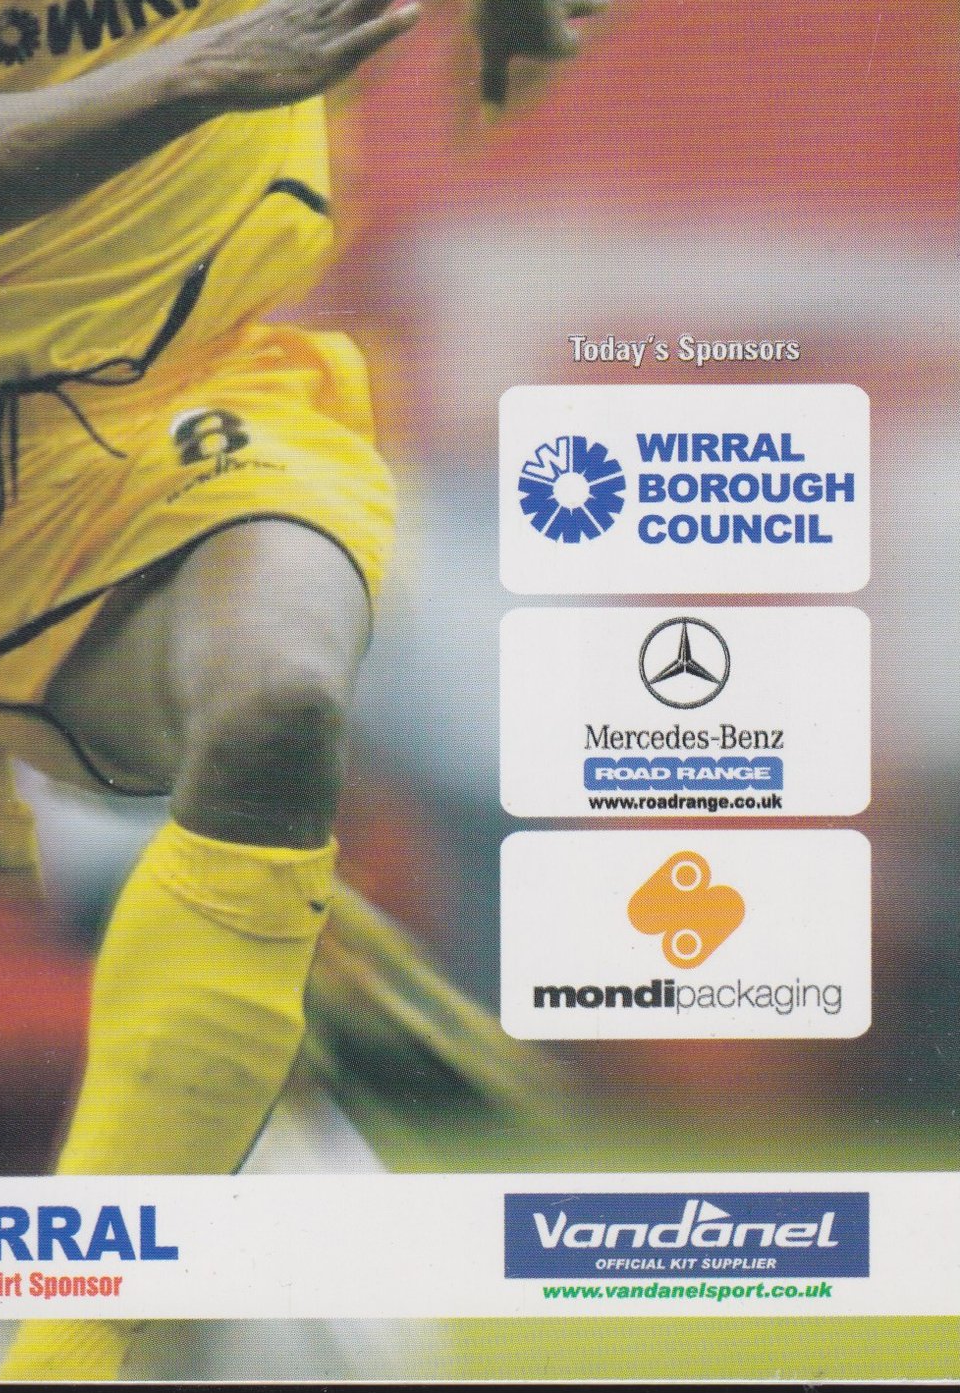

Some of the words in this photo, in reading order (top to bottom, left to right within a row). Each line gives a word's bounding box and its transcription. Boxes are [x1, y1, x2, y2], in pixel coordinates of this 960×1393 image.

[569, 335, 671, 368] Today's
[678, 333, 801, 367] Sponsors
[636, 432, 805, 462] WIRRAL
[638, 472, 855, 503] BOROUGH
[638, 513, 833, 544] COUNCIL
[584, 724, 785, 750] Mercedes-Benz
[595, 766, 671, 780] ROAD
[676, 766, 771, 780] RANGE
[588, 793, 783, 812] www.roadrange.co.uk
[533, 978, 843, 1015] mondipackaging
[533, 1199, 840, 1249] Vandanel
[595, 1258, 666, 1270] OFFICIAL
[670, 1258, 697, 1269] KIT
[701, 1257, 777, 1269] SUPPLIER
[29, 1271, 123, 1299] Sponsor
[542, 1282, 833, 1303] www.vandanelsport.co.uk
